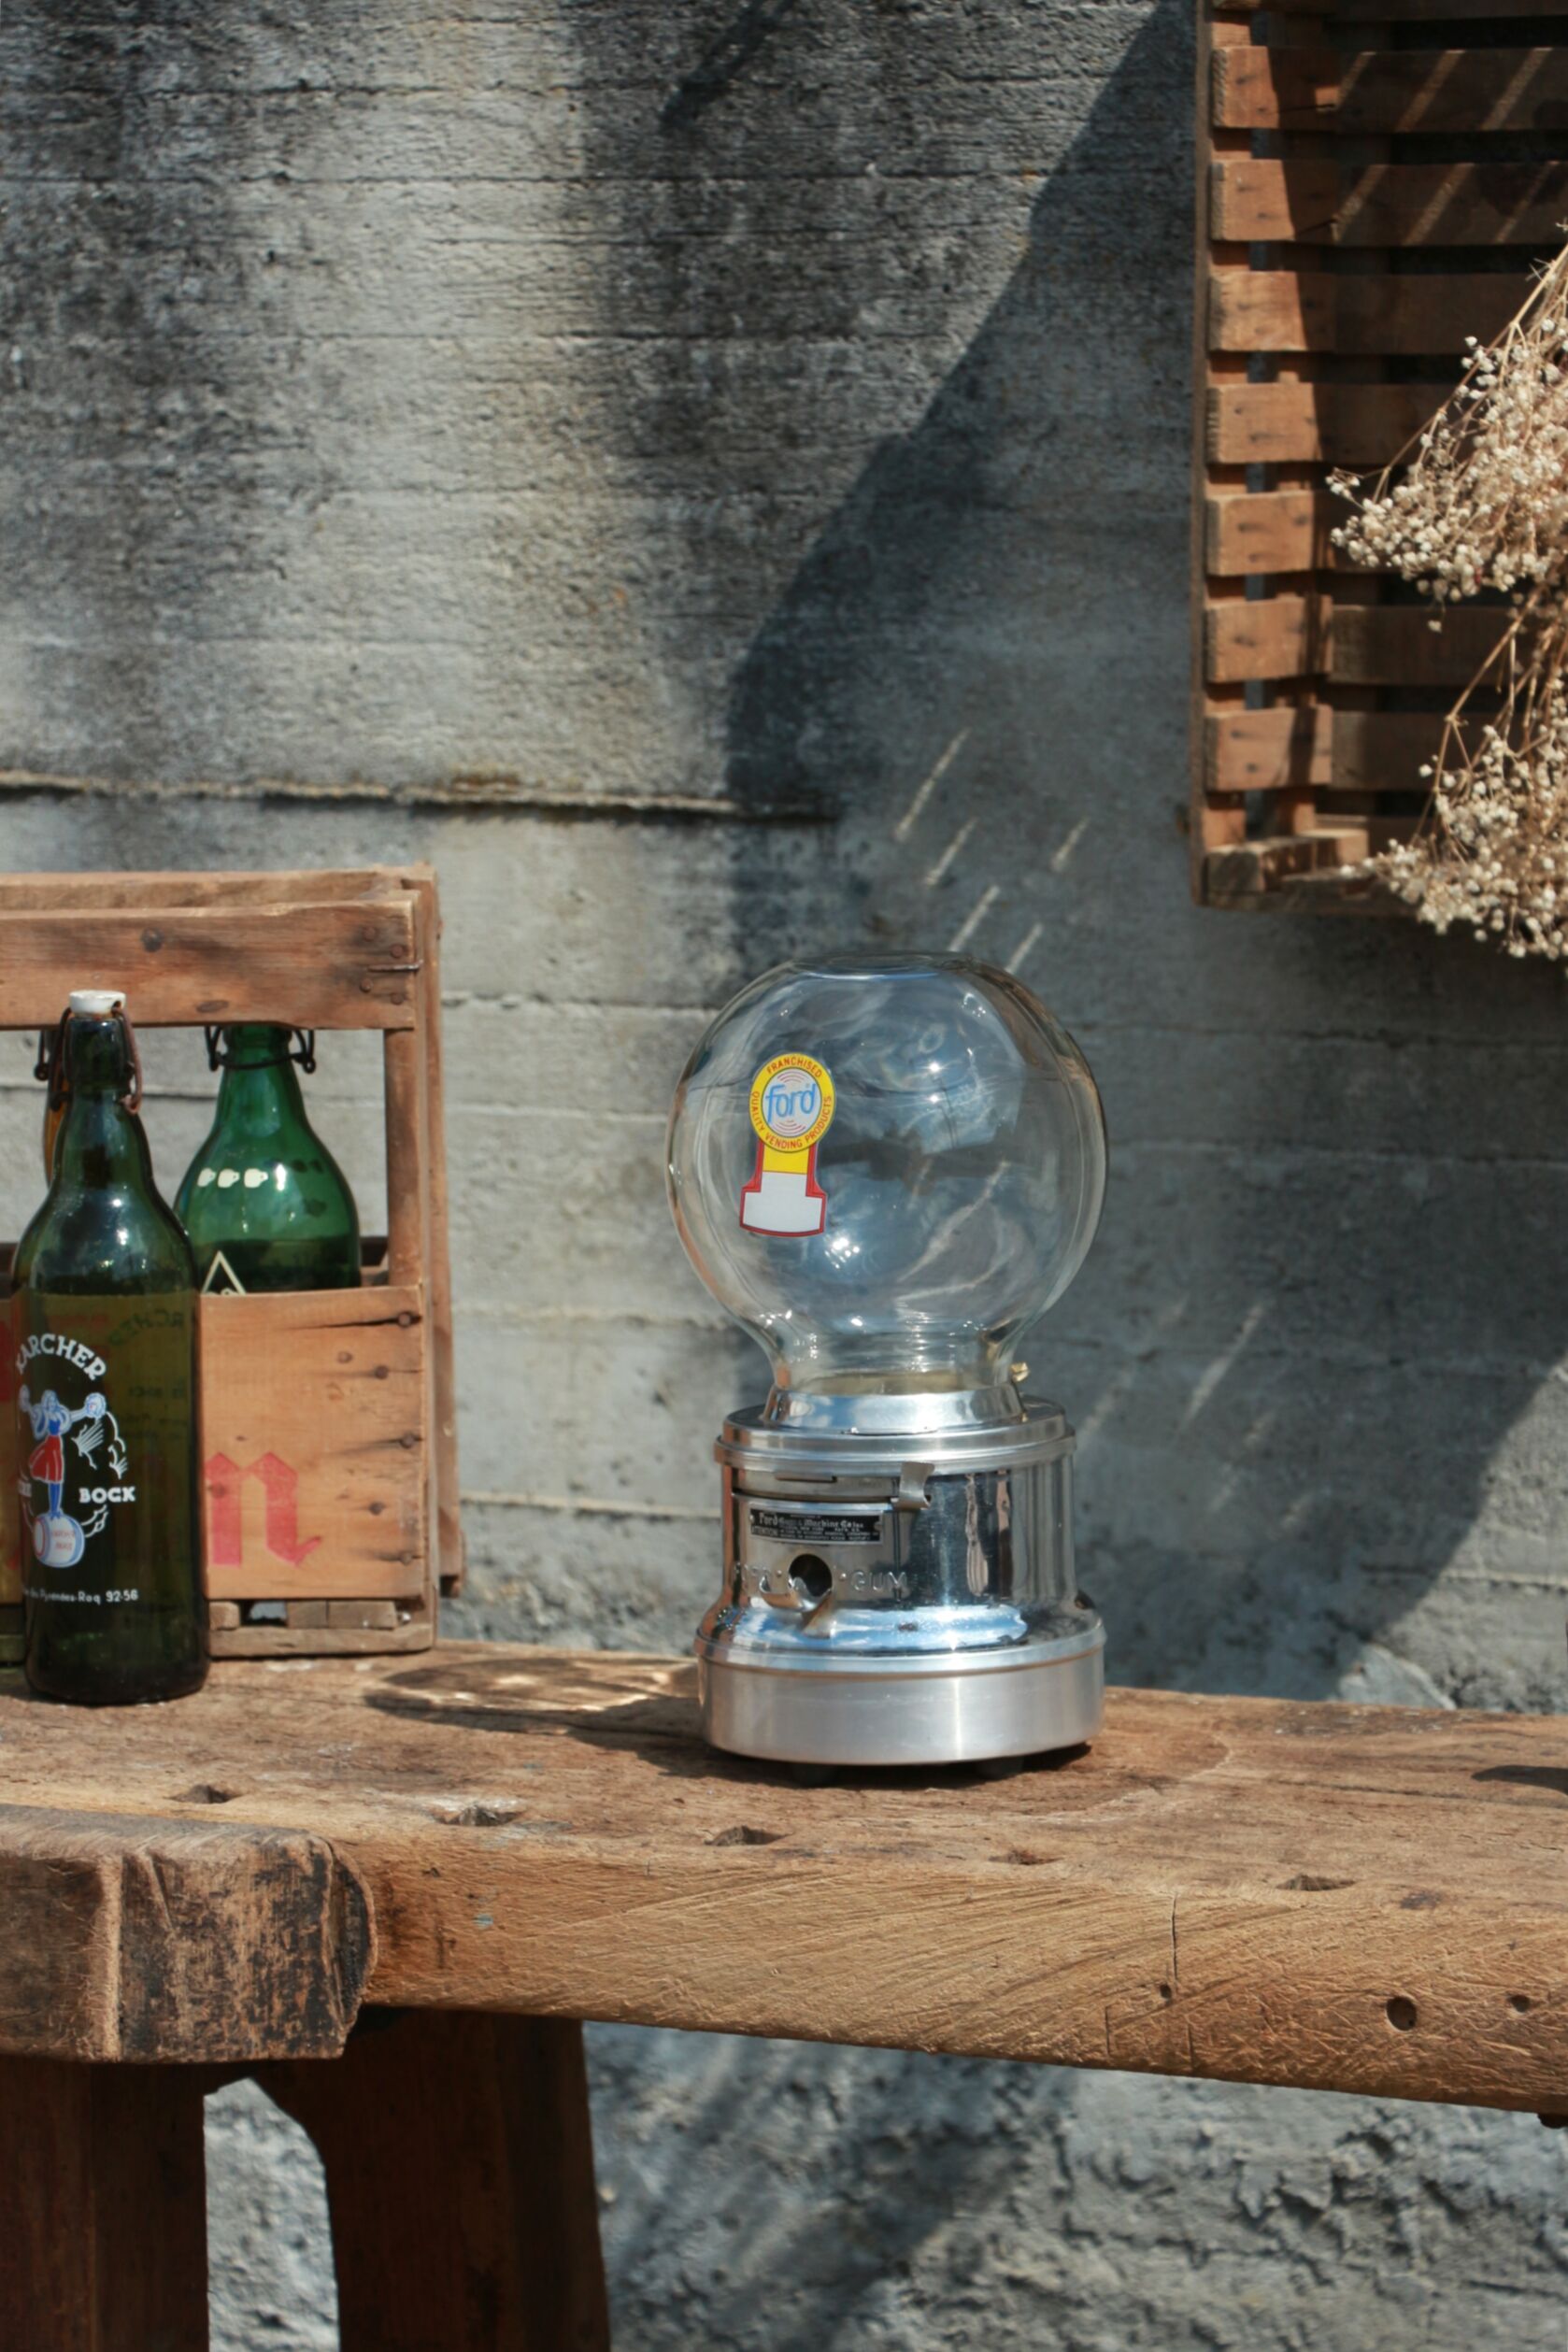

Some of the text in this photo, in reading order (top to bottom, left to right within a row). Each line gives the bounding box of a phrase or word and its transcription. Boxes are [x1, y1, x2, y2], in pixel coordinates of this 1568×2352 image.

[766, 1055, 822, 1078] FRANCHISED
[764, 1083, 817, 1125] ford
[750, 1090, 832, 1149] QUALITY VENDING PRODUCTS
[78, 1486, 136, 1504] BOCK
[850, 1571, 908, 1592] GUM
